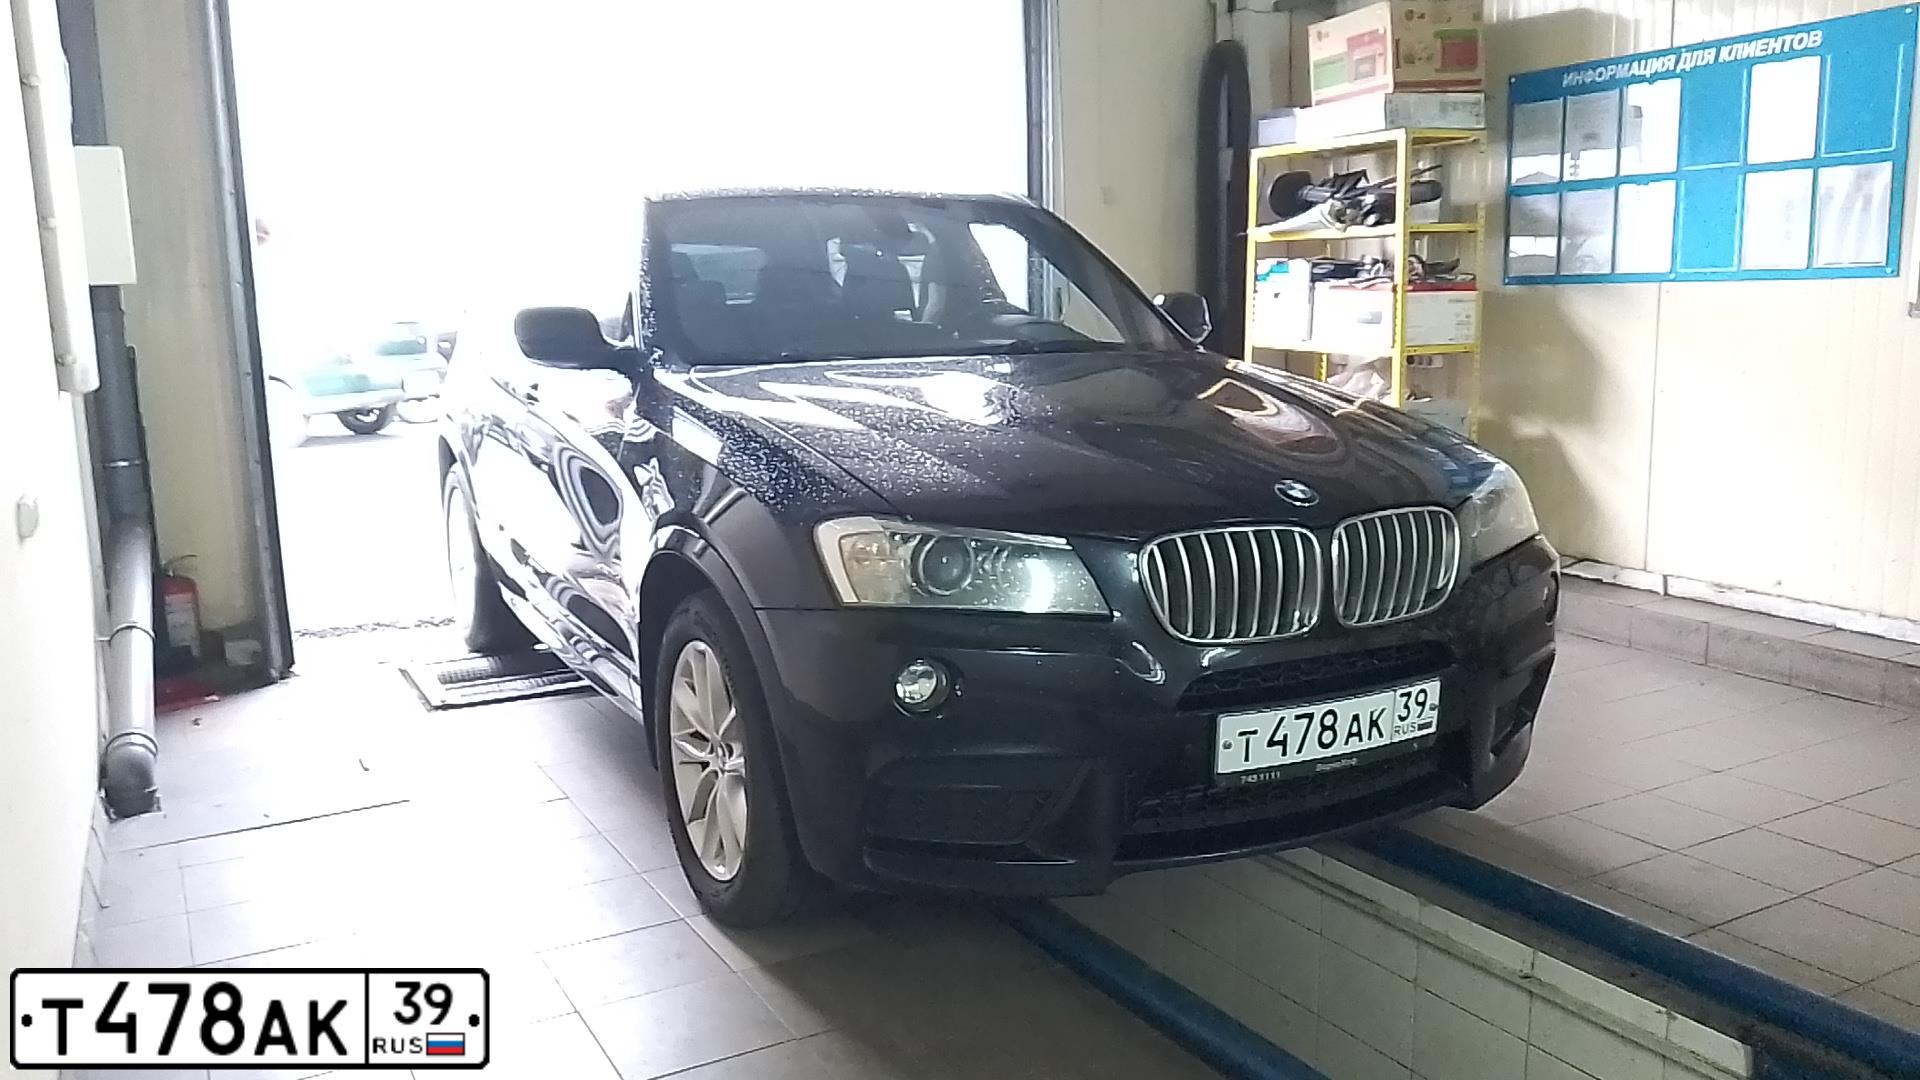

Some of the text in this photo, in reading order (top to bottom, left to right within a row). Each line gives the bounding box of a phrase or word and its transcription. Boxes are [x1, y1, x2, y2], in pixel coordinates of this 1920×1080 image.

[1562, 29, 1824, 88] ИНФОРМАЦИЯ ДЛЯ КЛИЕНТОВ
[1397, 688, 1428, 722] 39
[1393, 720, 1417, 737] RUS
